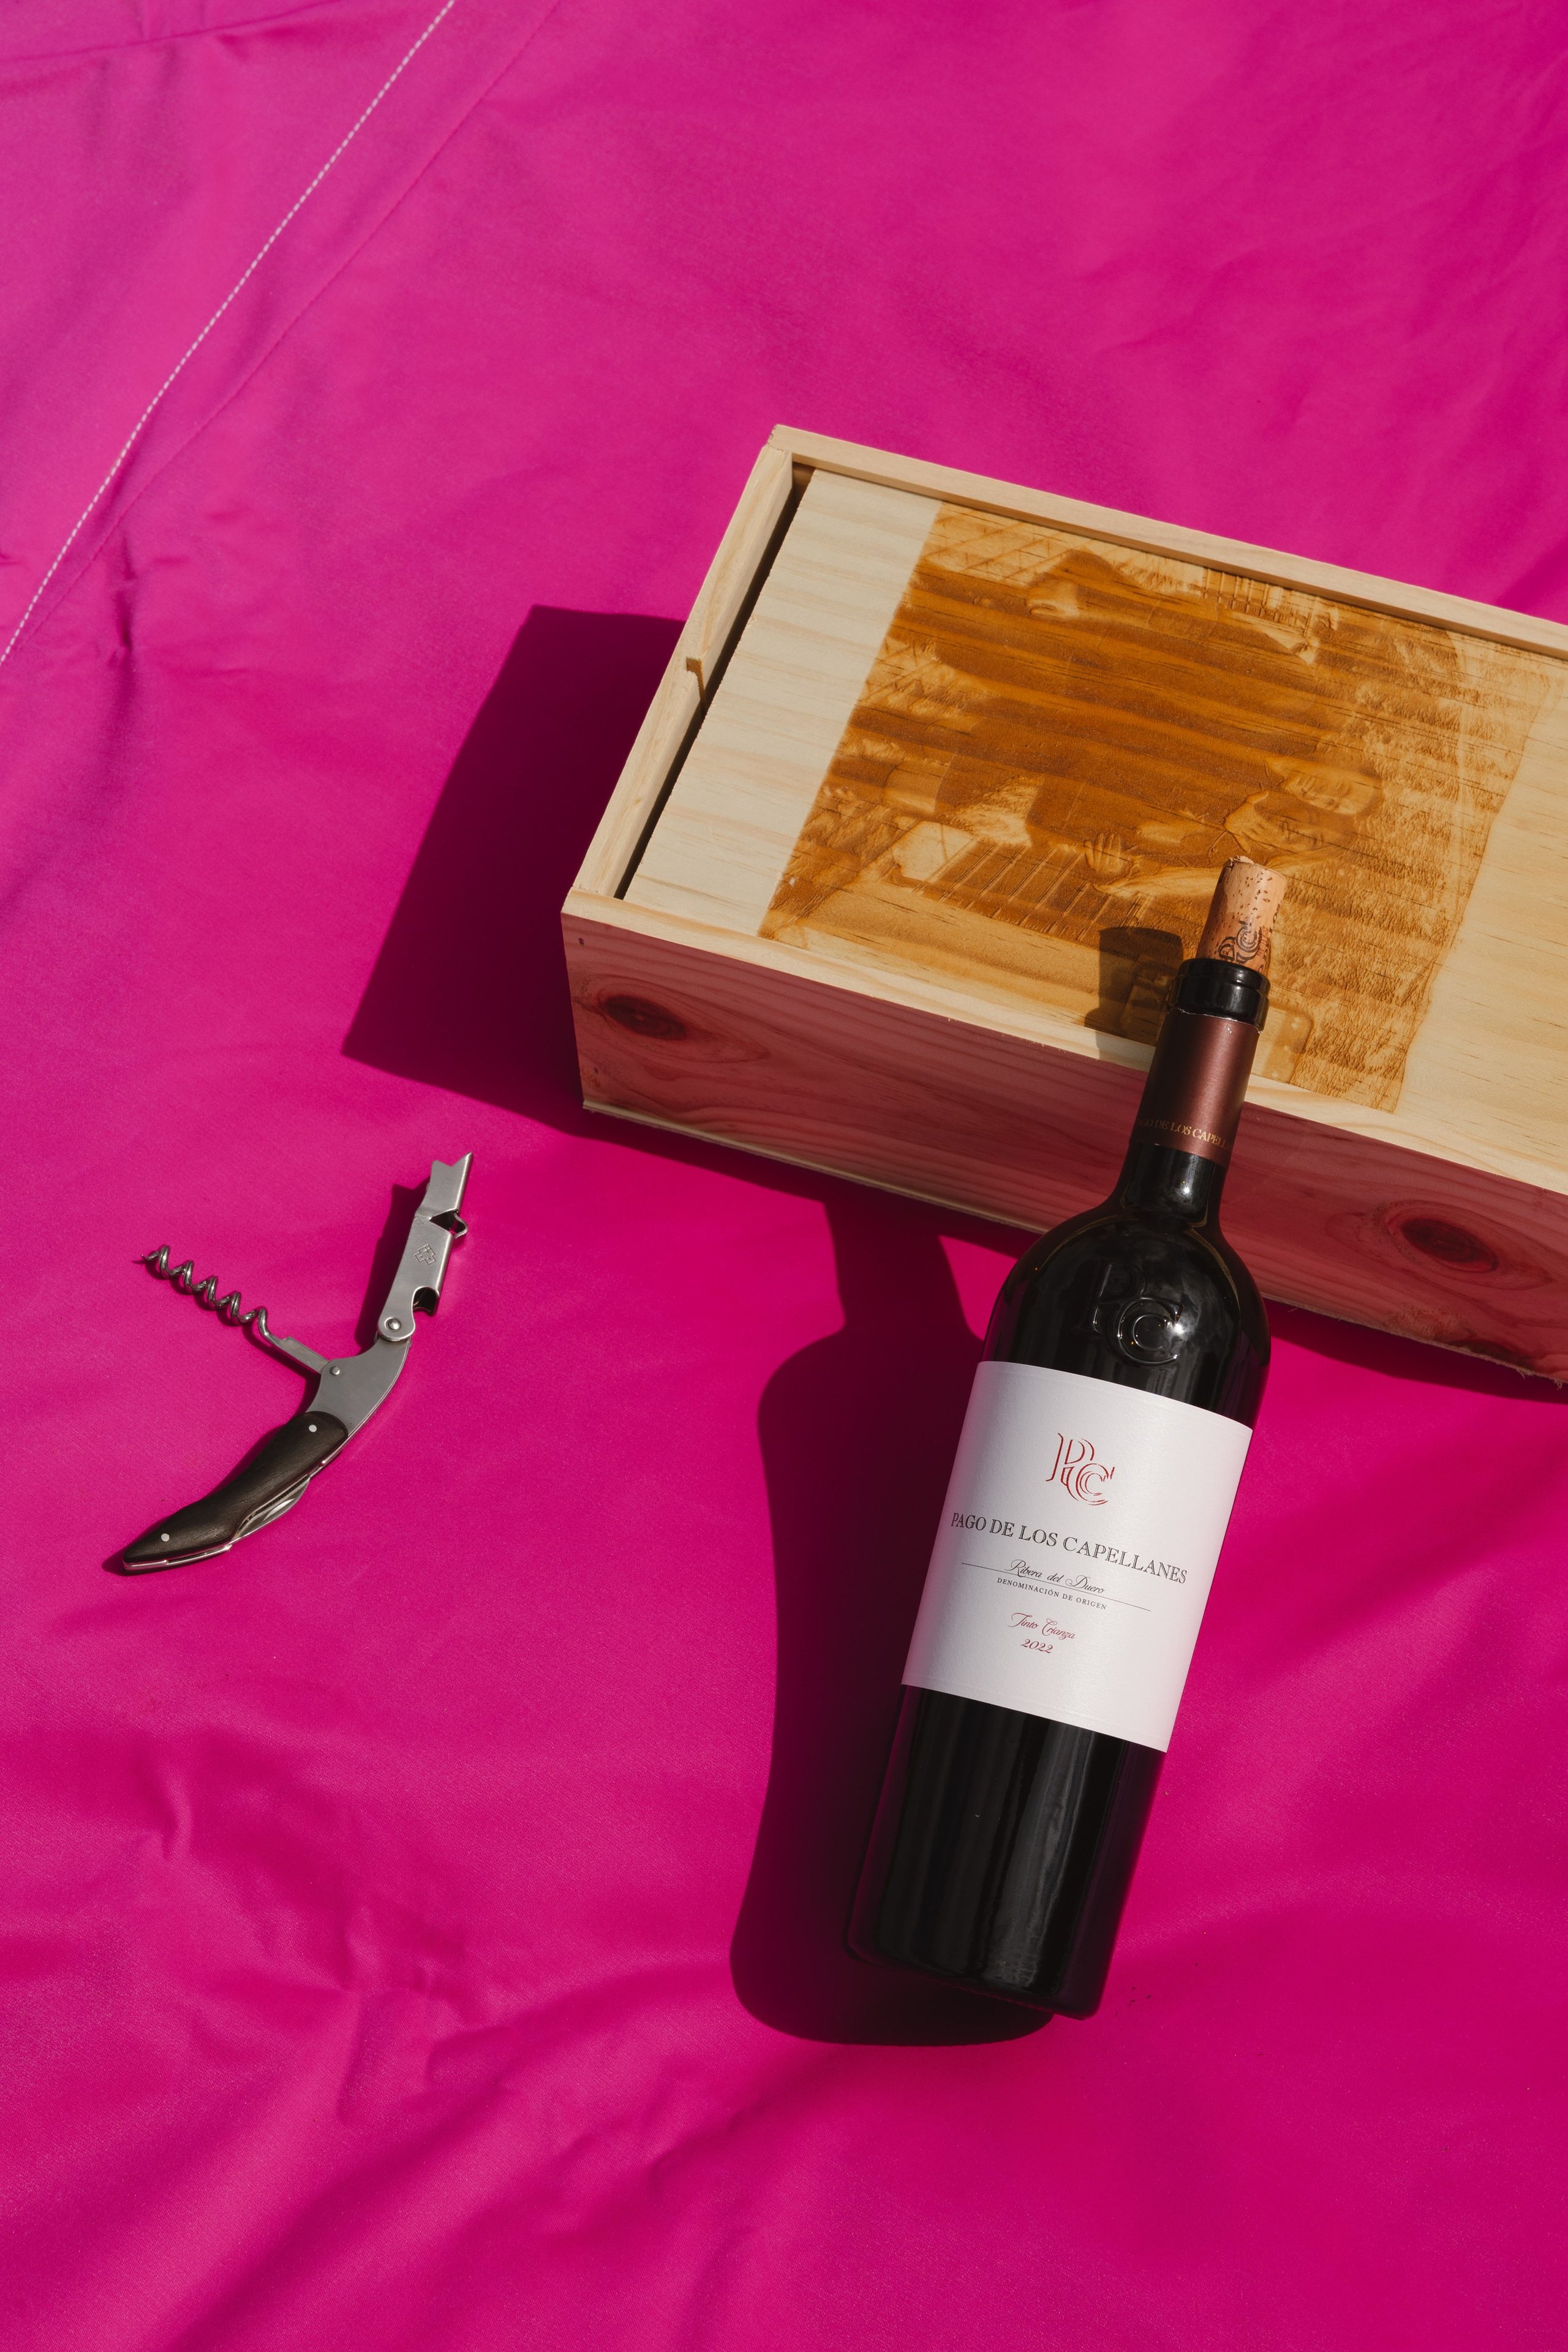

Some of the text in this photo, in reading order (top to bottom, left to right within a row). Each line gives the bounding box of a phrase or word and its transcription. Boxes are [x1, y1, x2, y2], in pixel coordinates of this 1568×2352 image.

[1155, 1120, 1169, 1130] DE
[1170, 1122, 1192, 1135] LOS
[950, 1512, 1188, 1585] PAGO DE LOS CAPELLANES
[1004, 1559, 1106, 1594] Ribera del Duero
[997, 1577, 1060, 1597] DENOMINACIÓN
[1076, 1597, 1107, 1610] ORIGEN
[1008, 1612, 1076, 1640] Tinto Crianza
[1020, 1638, 1054, 1654] 2022
